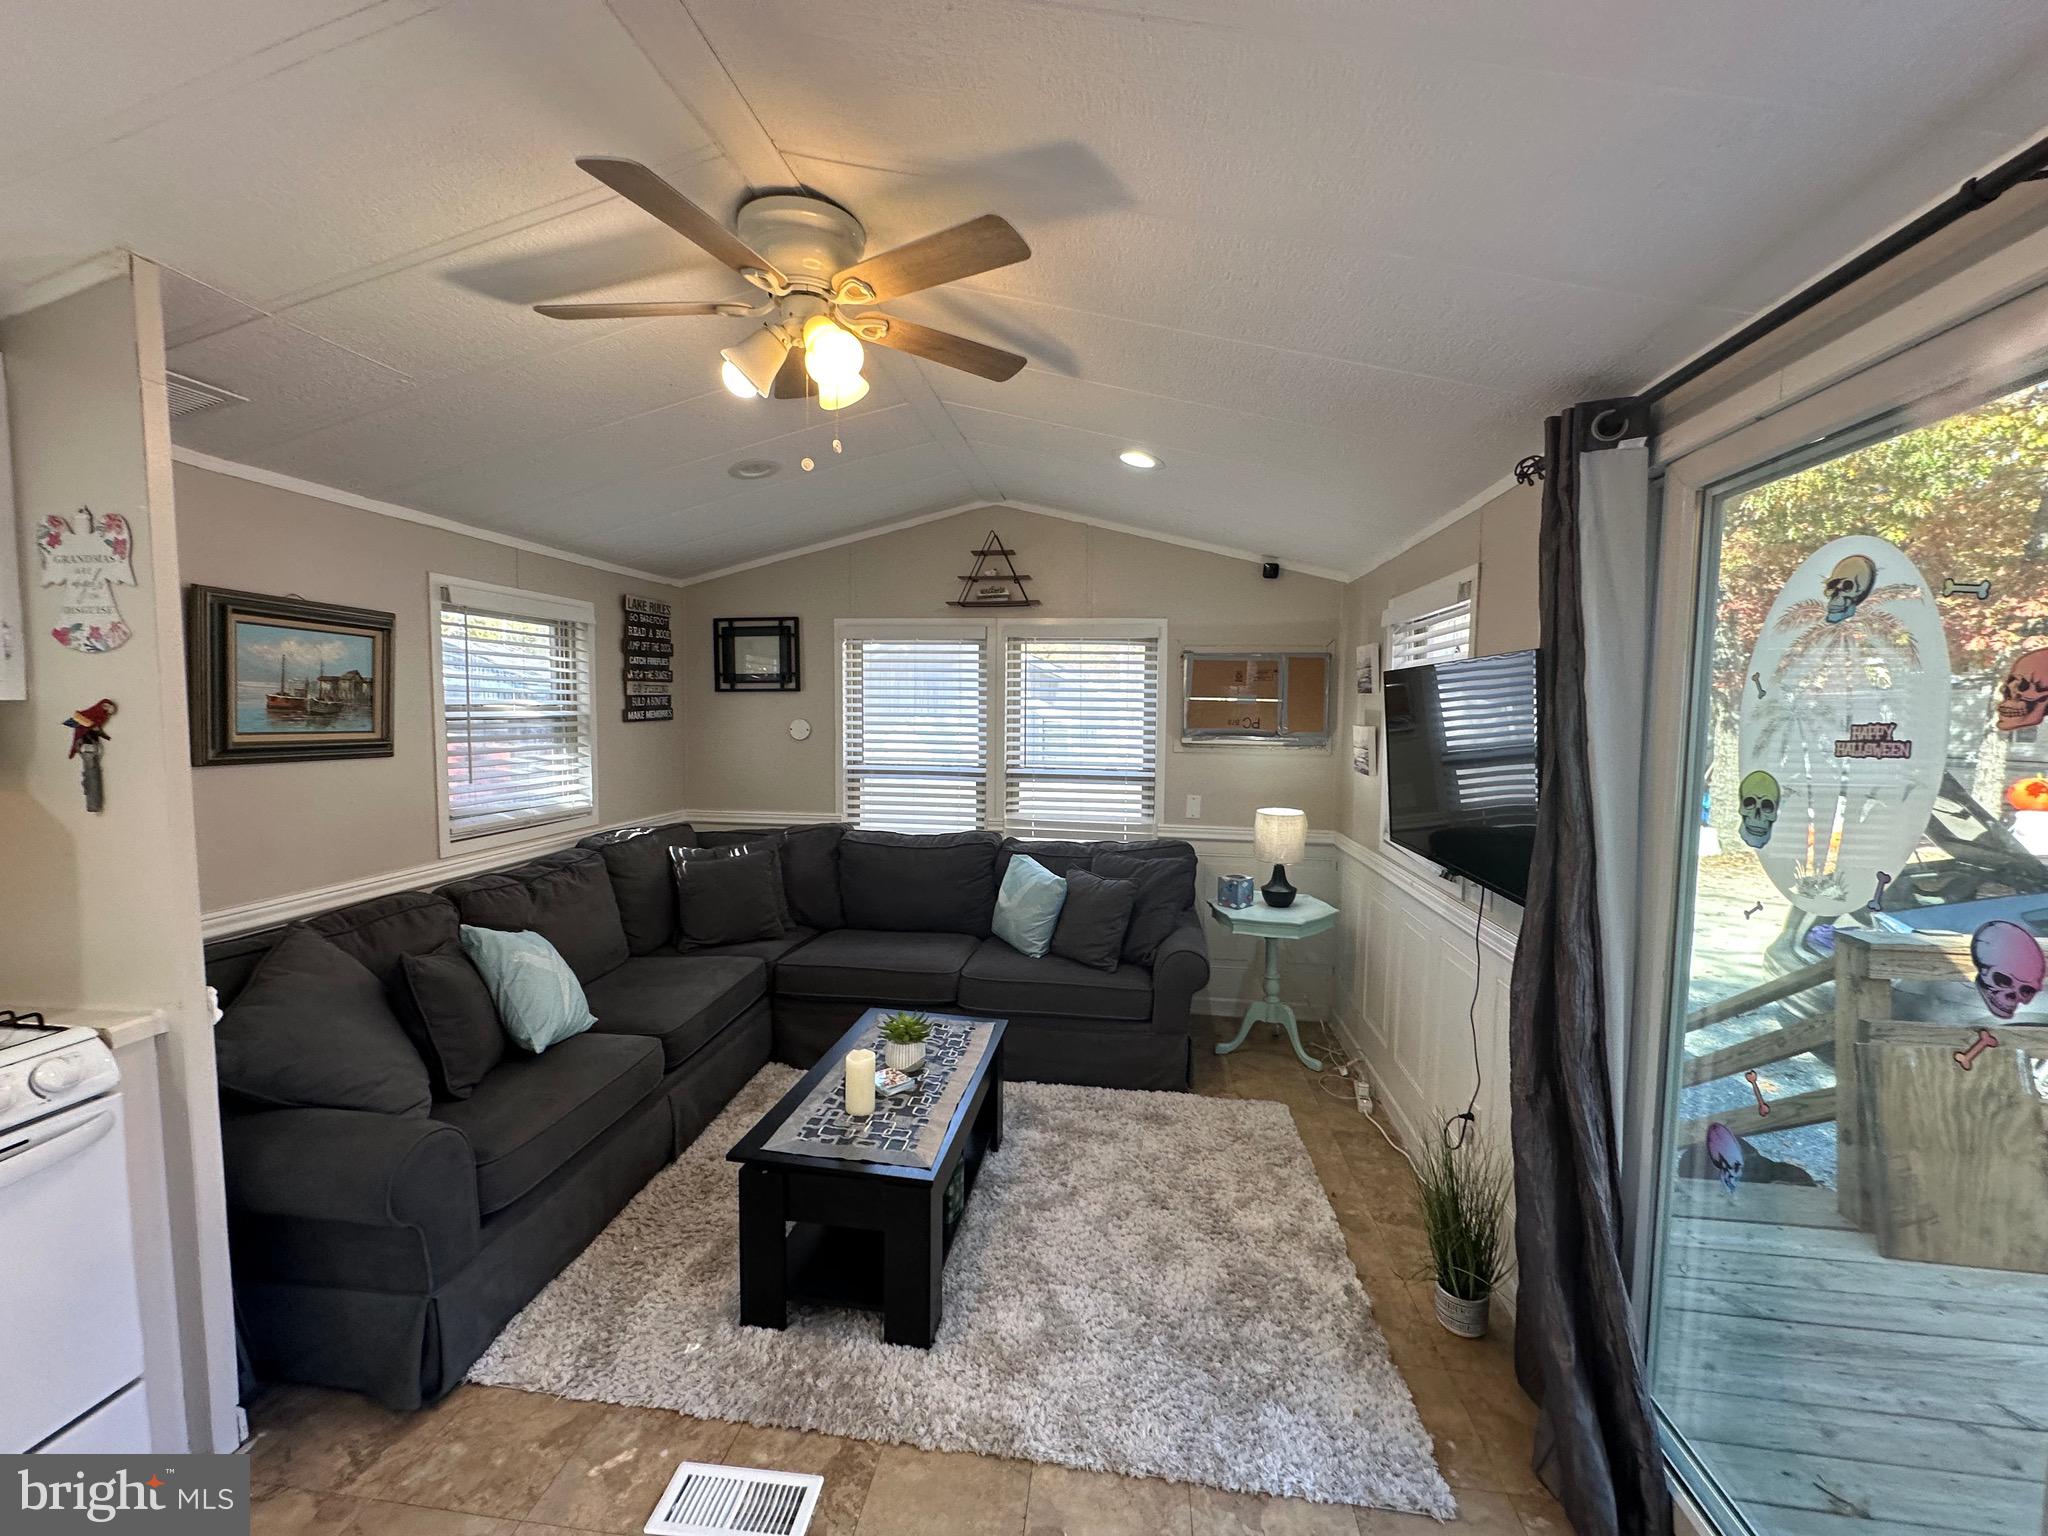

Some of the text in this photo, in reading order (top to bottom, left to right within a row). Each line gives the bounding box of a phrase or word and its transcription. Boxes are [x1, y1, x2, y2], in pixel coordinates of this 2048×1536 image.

[627, 597, 671, 616] LAKE RULES
[630, 613, 669, 626] GO BAREFOOT
[628, 626, 670, 640] READ A BOOK
[627, 641, 640, 651] JUMP
[629, 656, 646, 666] CATCH
[627, 670, 643, 680] WATCH
[632, 697, 645, 707] BUILD
[628, 710, 672, 721] MAKE MEMORIES
[1852, 724, 1895, 740] HAPPY
[1835, 741, 1910, 758] HALLOWEEN
